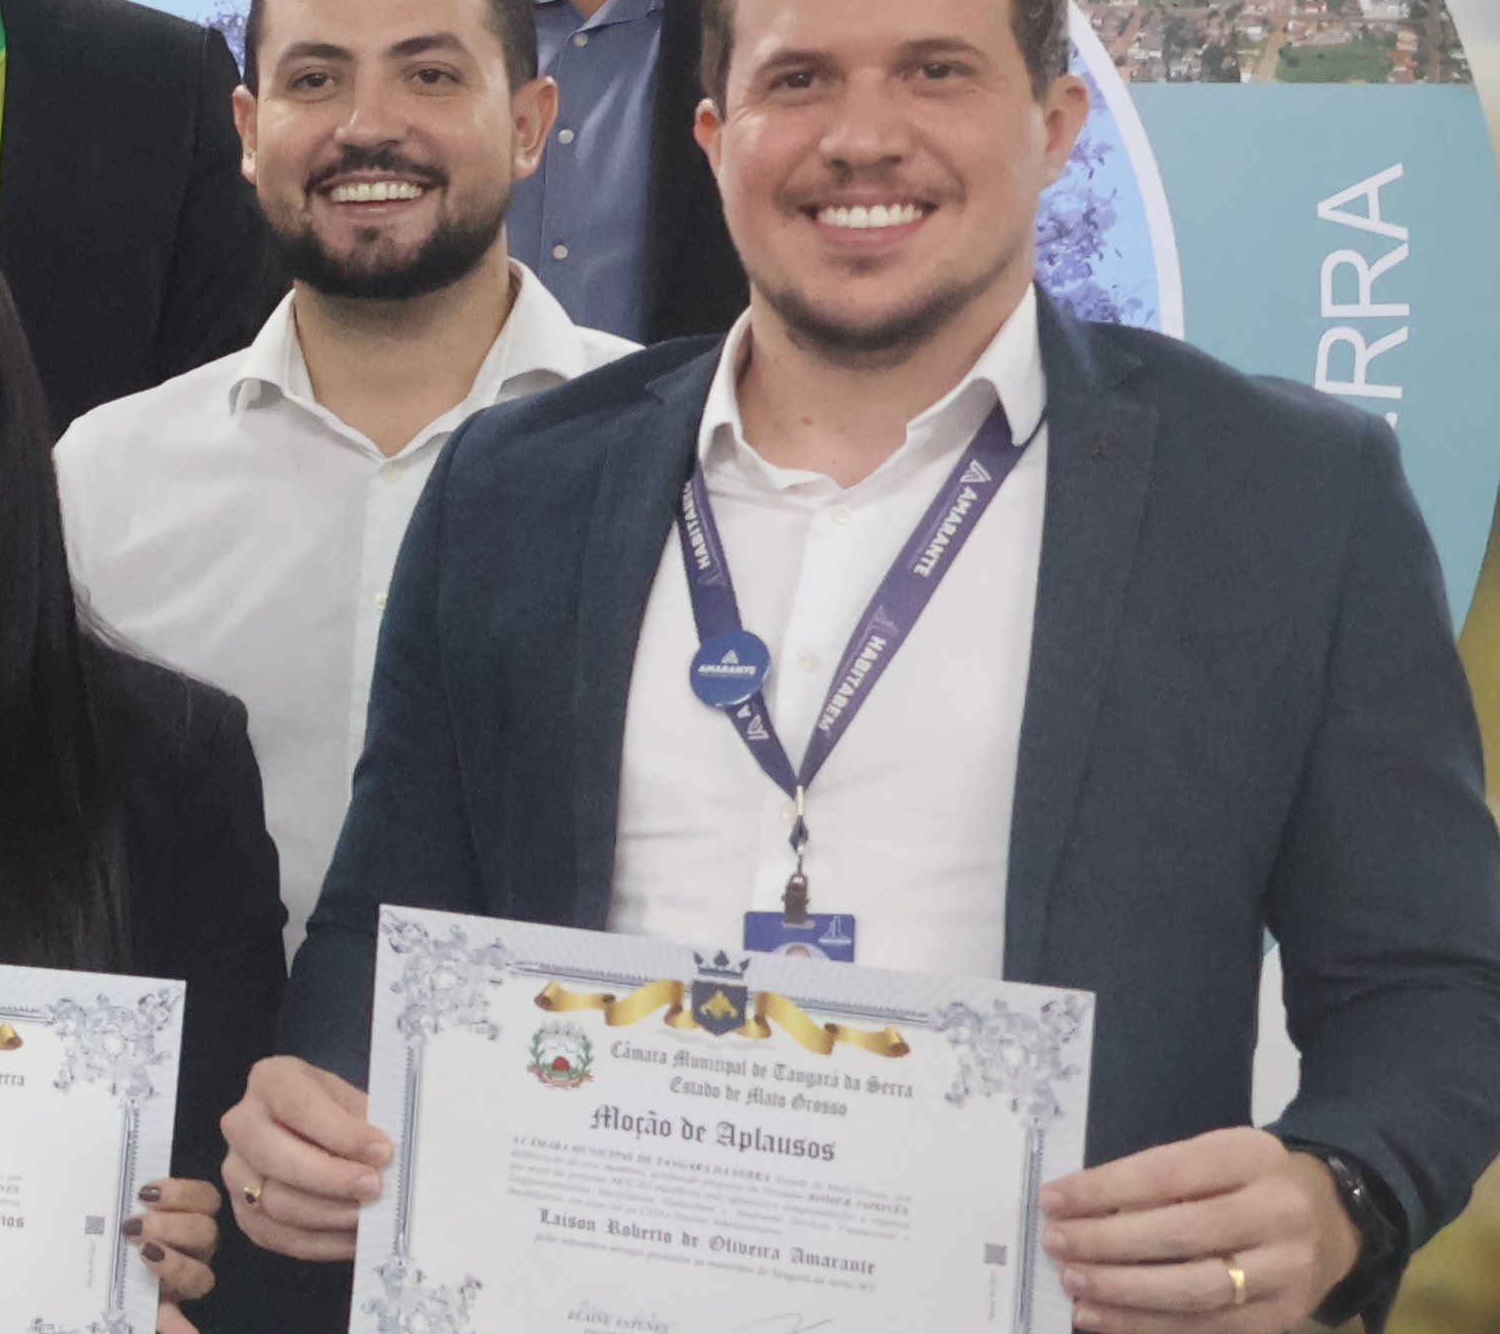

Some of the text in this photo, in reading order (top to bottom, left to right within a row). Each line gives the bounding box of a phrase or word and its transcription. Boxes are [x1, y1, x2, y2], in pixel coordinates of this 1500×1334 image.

[1314, 162, 1411, 427] RRA
[913, 484, 978, 577] AMARANTE
[698, 664, 757, 676] AMARANTE
[817, 634, 887, 733] HABITABEM
[610, 1040, 912, 1097] Câmara Municipal de Tangará da Serra
[669, 1075, 847, 1116] Estado de Mato Grosso
[589, 1104, 835, 1161] Moção de Aplausos
[606, 1218, 671, 1243] Roberto
[681, 1230, 698, 1247] de
[709, 1235, 779, 1259] Oliveira
[791, 1247, 875, 1274] Amarante
